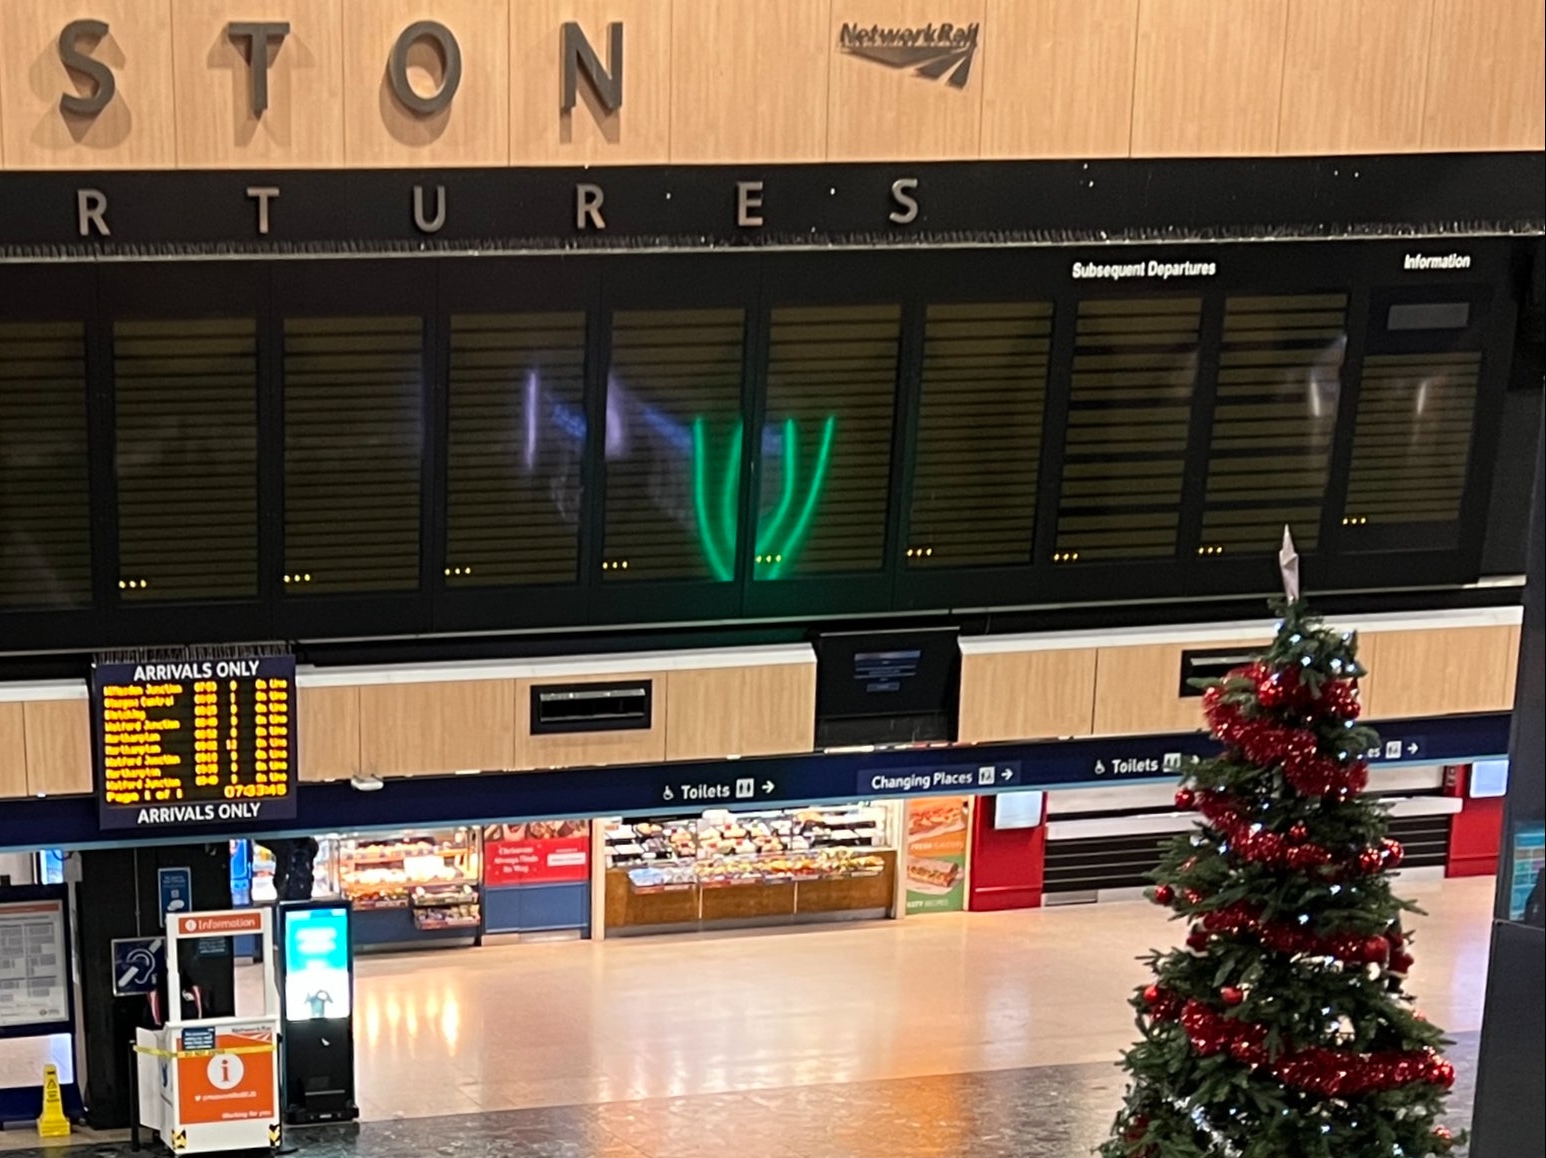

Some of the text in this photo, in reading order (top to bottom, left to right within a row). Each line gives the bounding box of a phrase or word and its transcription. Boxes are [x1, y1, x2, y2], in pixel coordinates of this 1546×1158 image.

[1072, 259, 1216, 280] Subsequent Departures
[1404, 252, 1471, 270] Information
[133, 660, 260, 681] ARRIVALS ONLY
[1111, 758, 1159, 774] Toilets
[871, 771, 973, 790] Changing Places
[680, 784, 730, 800] Toilets
[137, 802, 261, 824] ARRIVALS ONLY
[198, 918, 255, 930] Information
